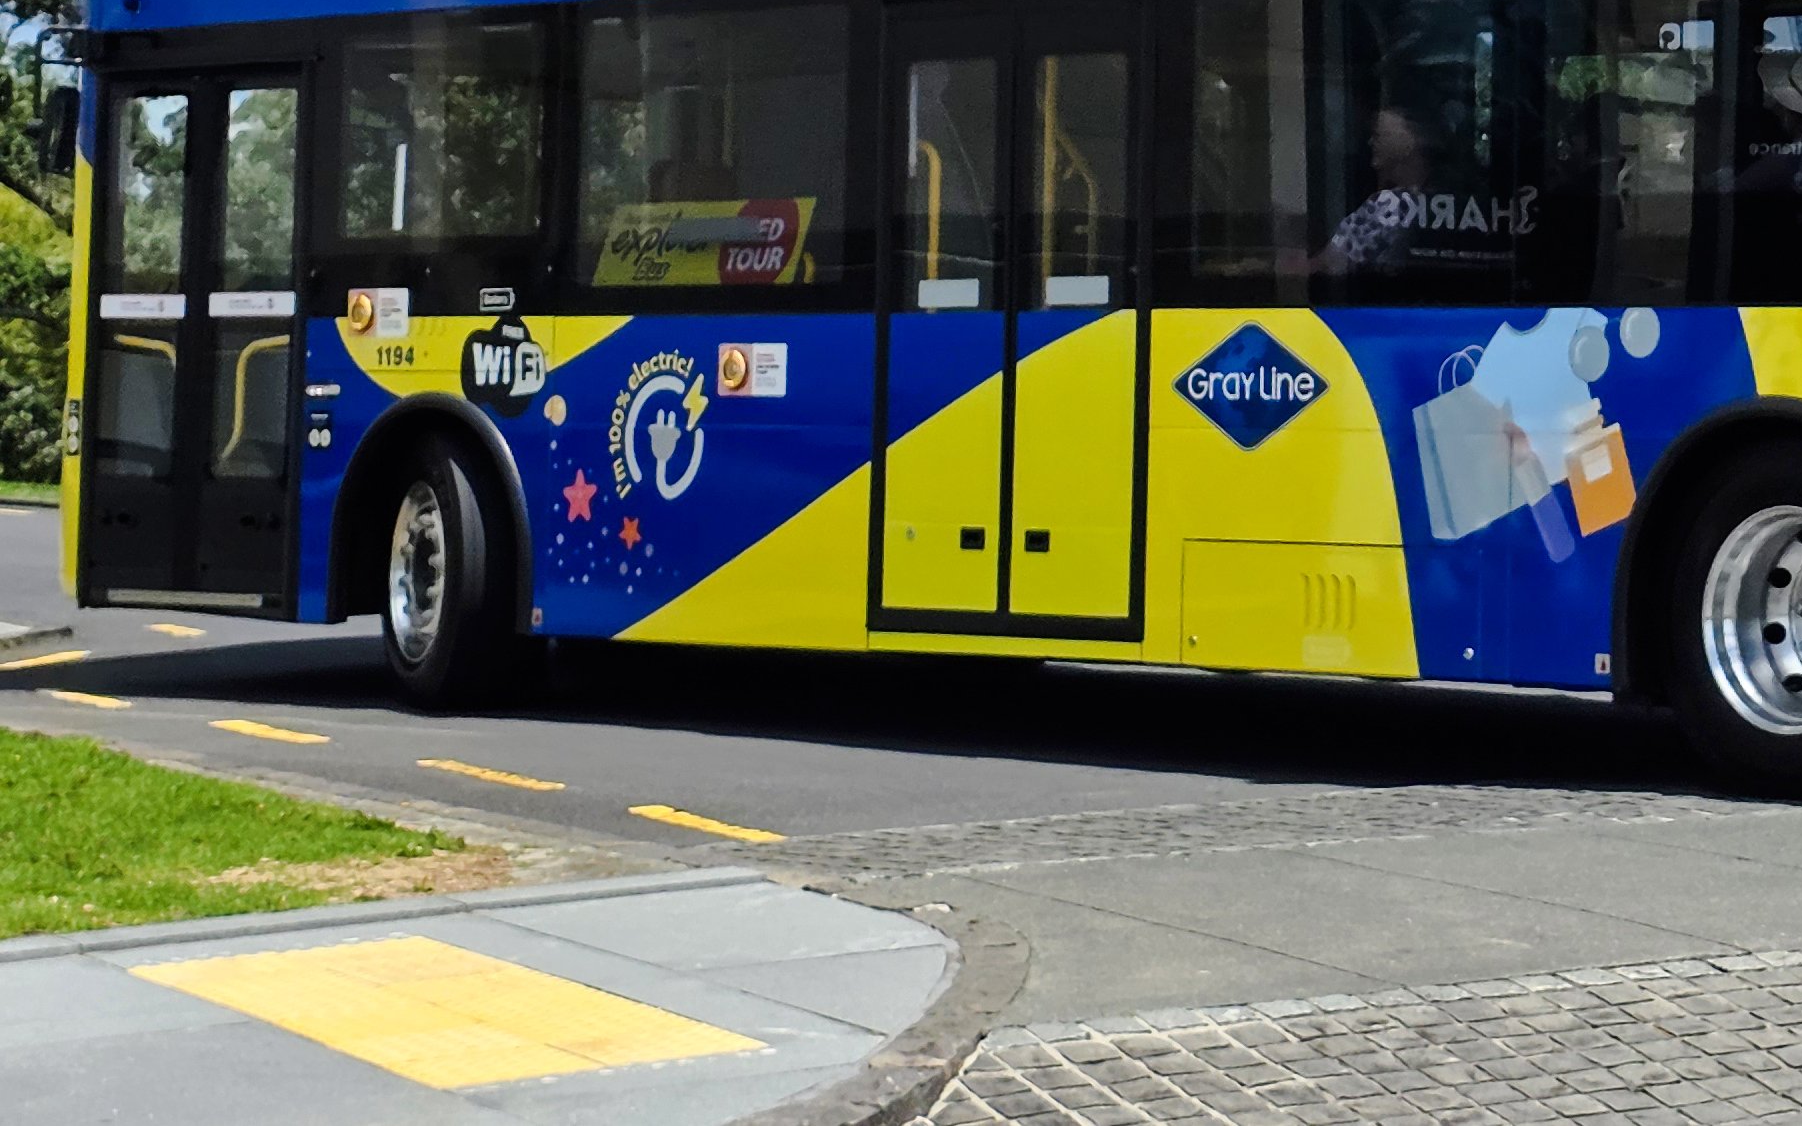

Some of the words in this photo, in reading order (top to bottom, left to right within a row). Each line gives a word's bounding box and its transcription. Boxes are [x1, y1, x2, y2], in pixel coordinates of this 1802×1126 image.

[726, 245, 785, 272] TOUR
[376, 345, 415, 366] 1194
[627, 348, 695, 391] electric!
